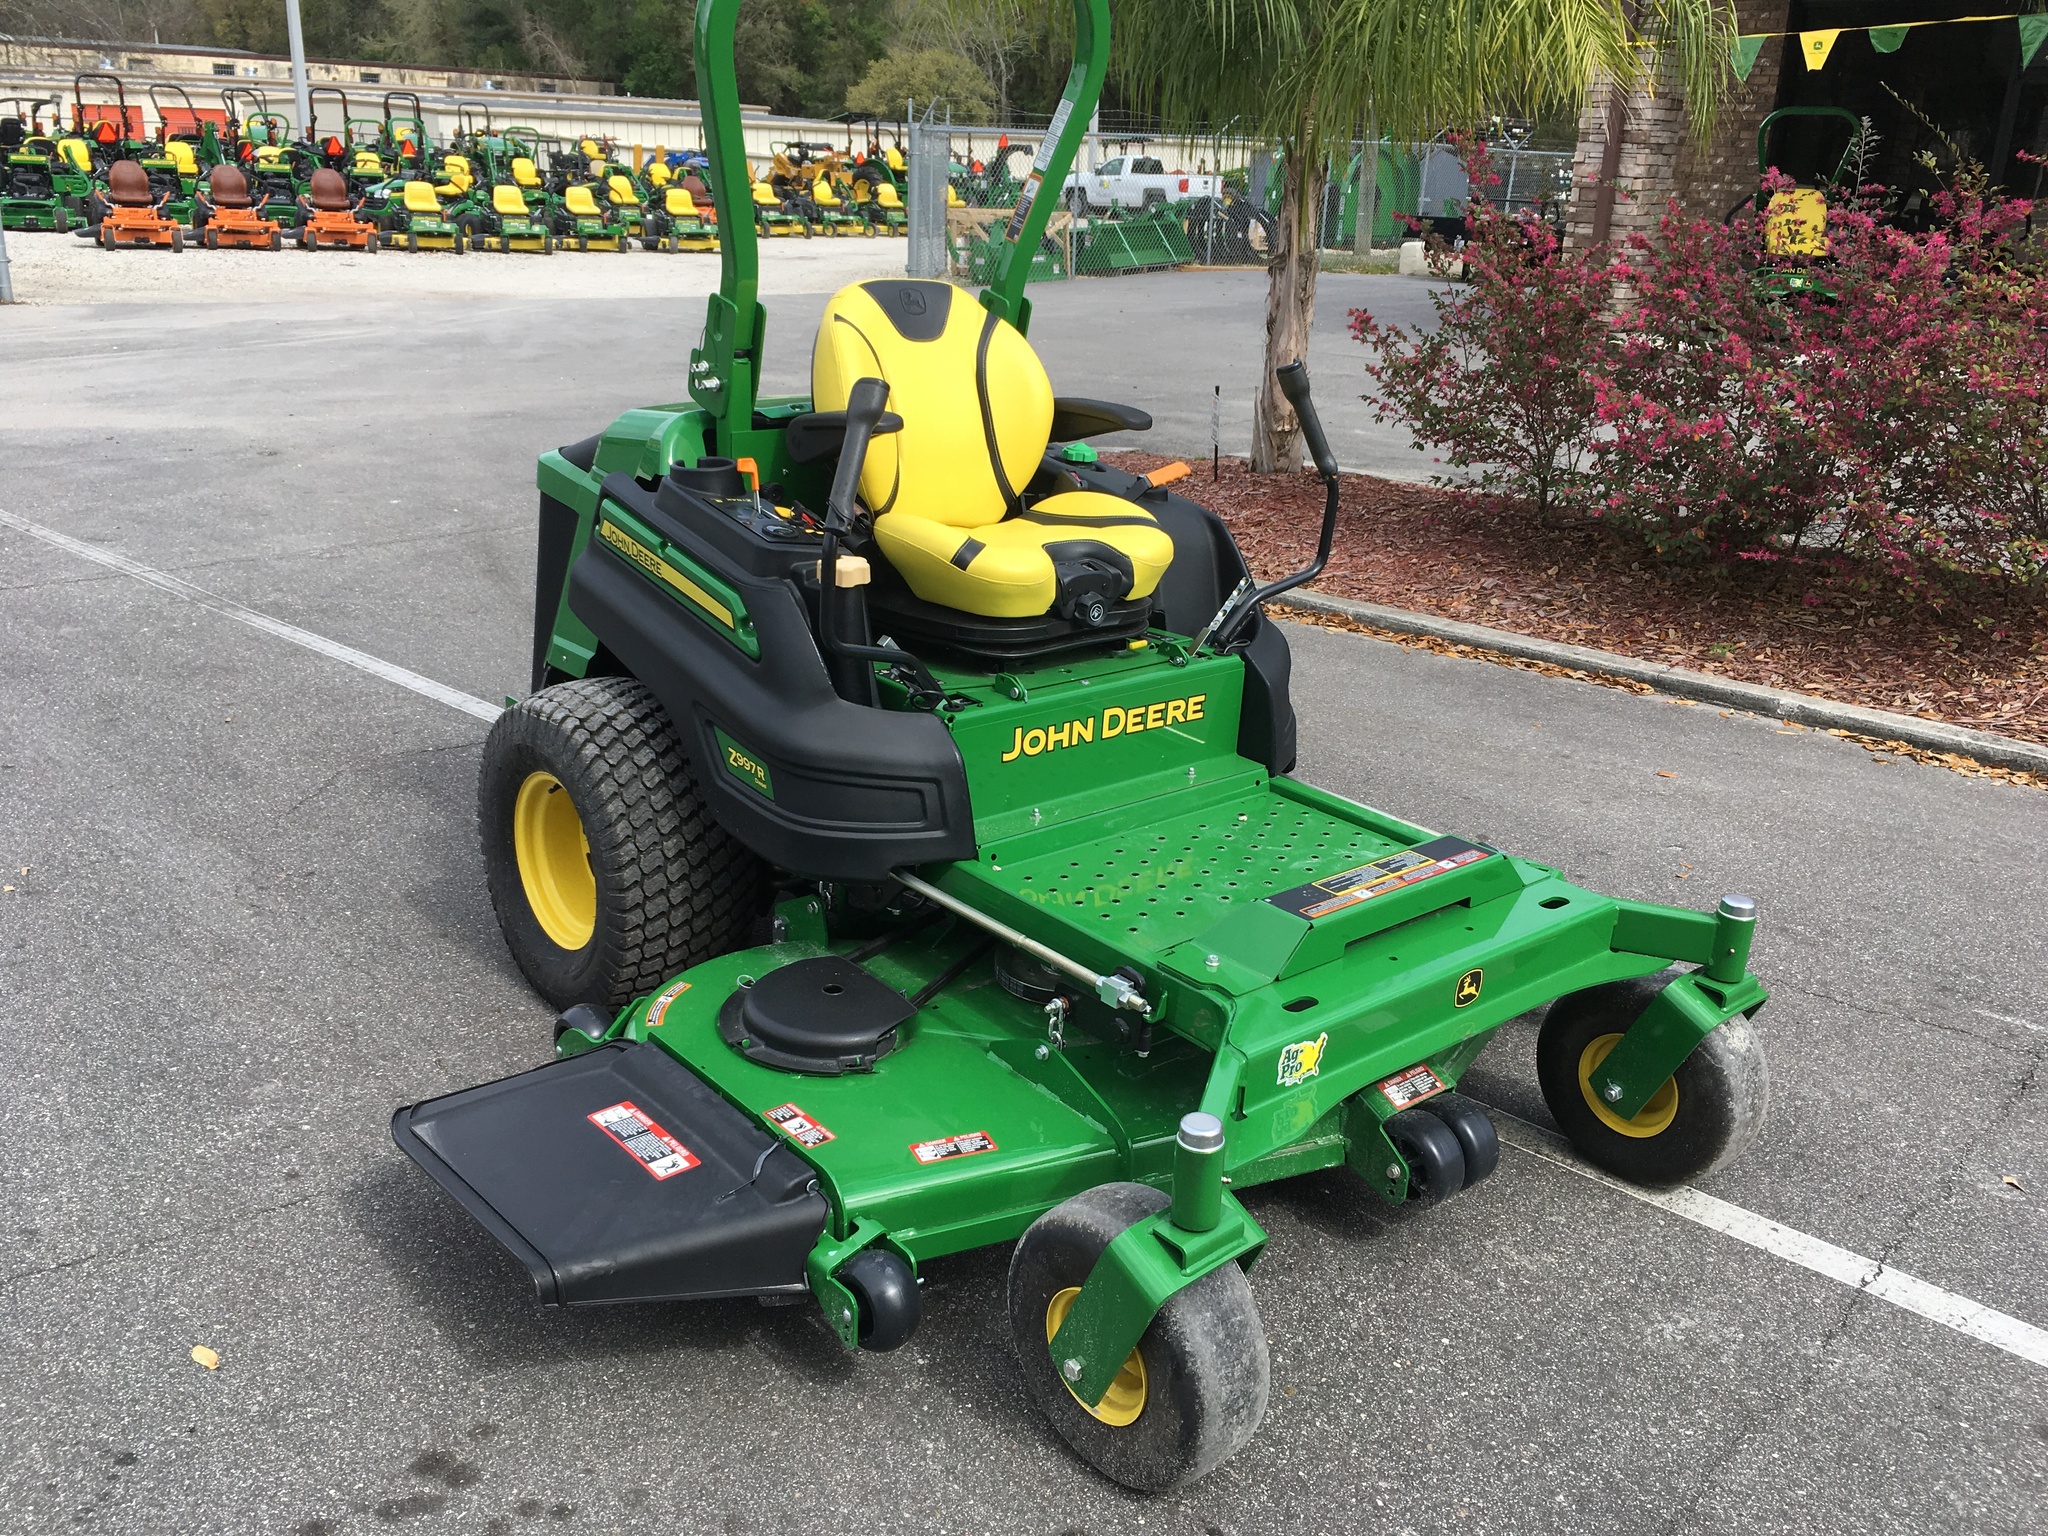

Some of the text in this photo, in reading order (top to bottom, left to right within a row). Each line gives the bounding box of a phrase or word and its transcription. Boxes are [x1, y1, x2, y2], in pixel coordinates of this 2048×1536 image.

[605, 526, 663, 578] JOHN DEERE
[1001, 693, 1206, 763] JOHN DEERE
[1280, 1061, 1303, 1080] Pro
[1281, 1048, 1304, 1065] Ag-
